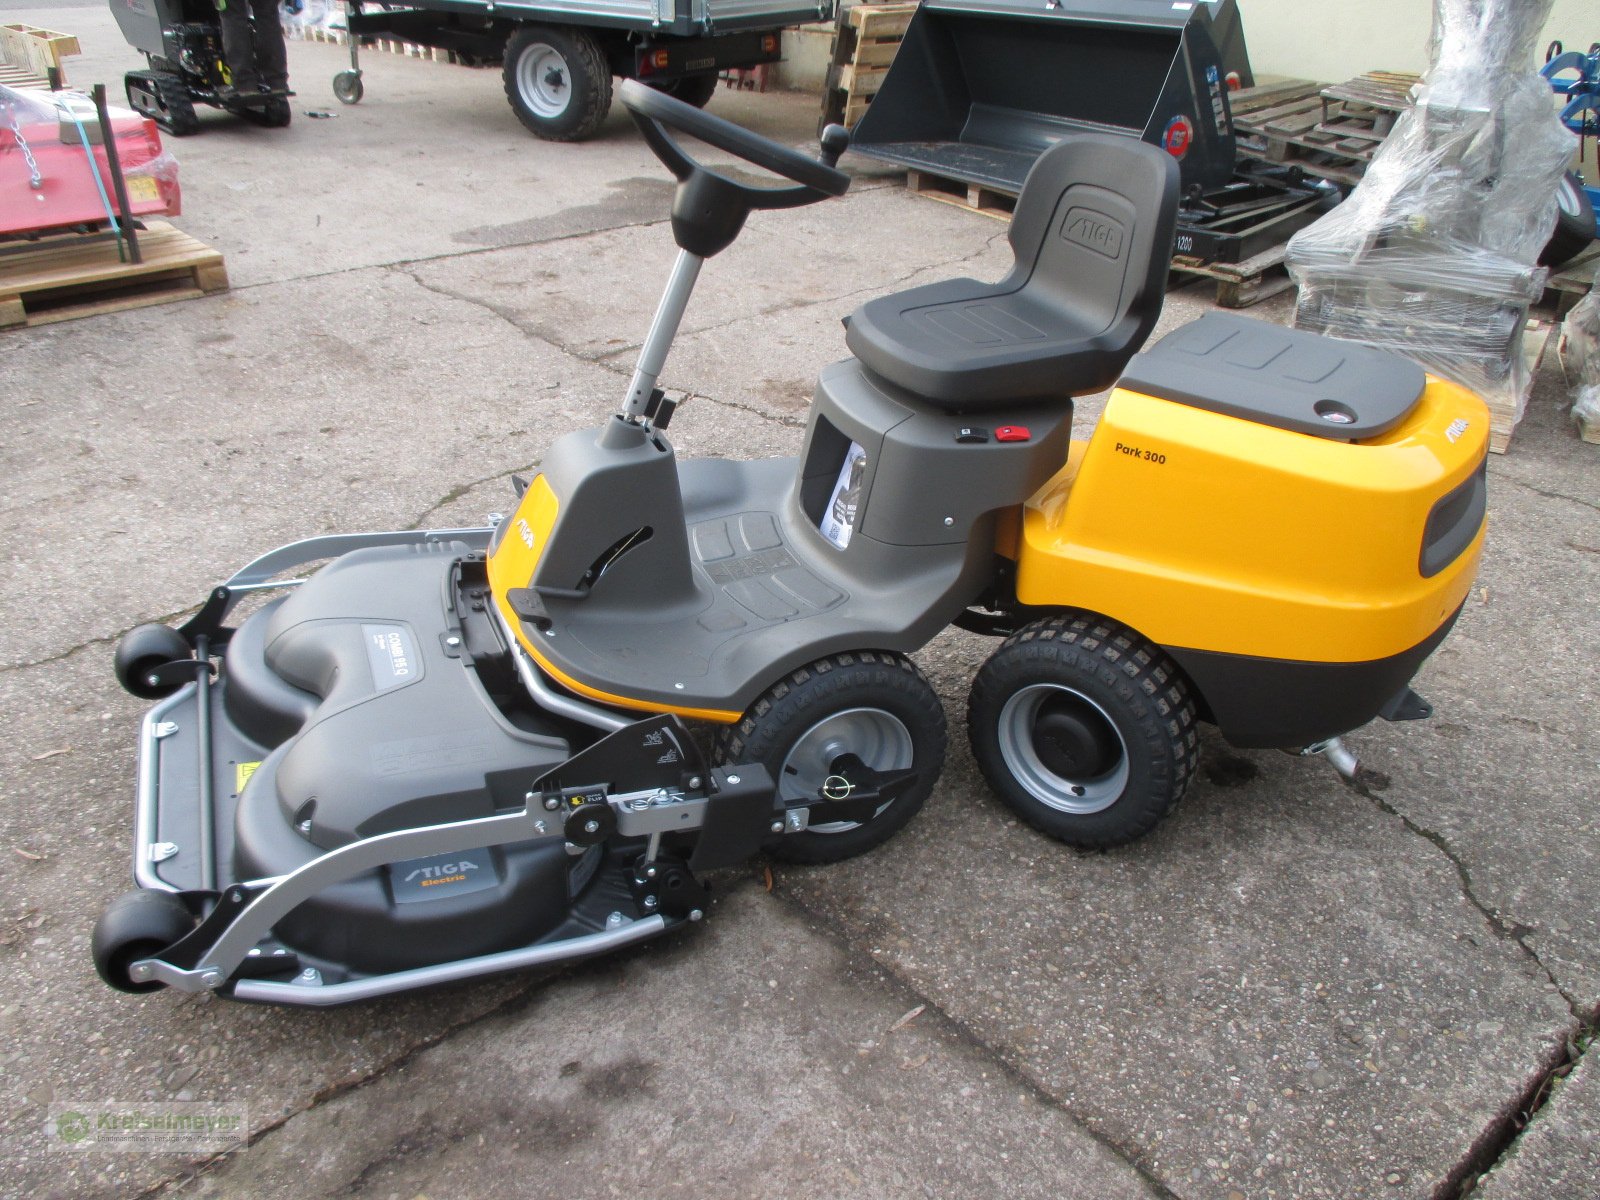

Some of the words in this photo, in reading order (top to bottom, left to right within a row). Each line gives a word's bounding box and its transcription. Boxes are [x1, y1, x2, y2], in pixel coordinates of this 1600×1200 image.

[1177, 235, 1193, 252] 1200
[1115, 442, 1142, 458] Park
[1144, 450, 1166, 465] 300
[387, 632, 404, 658] COMBI
[404, 860, 479, 882] STIGA
[420, 874, 466, 887] Electric
